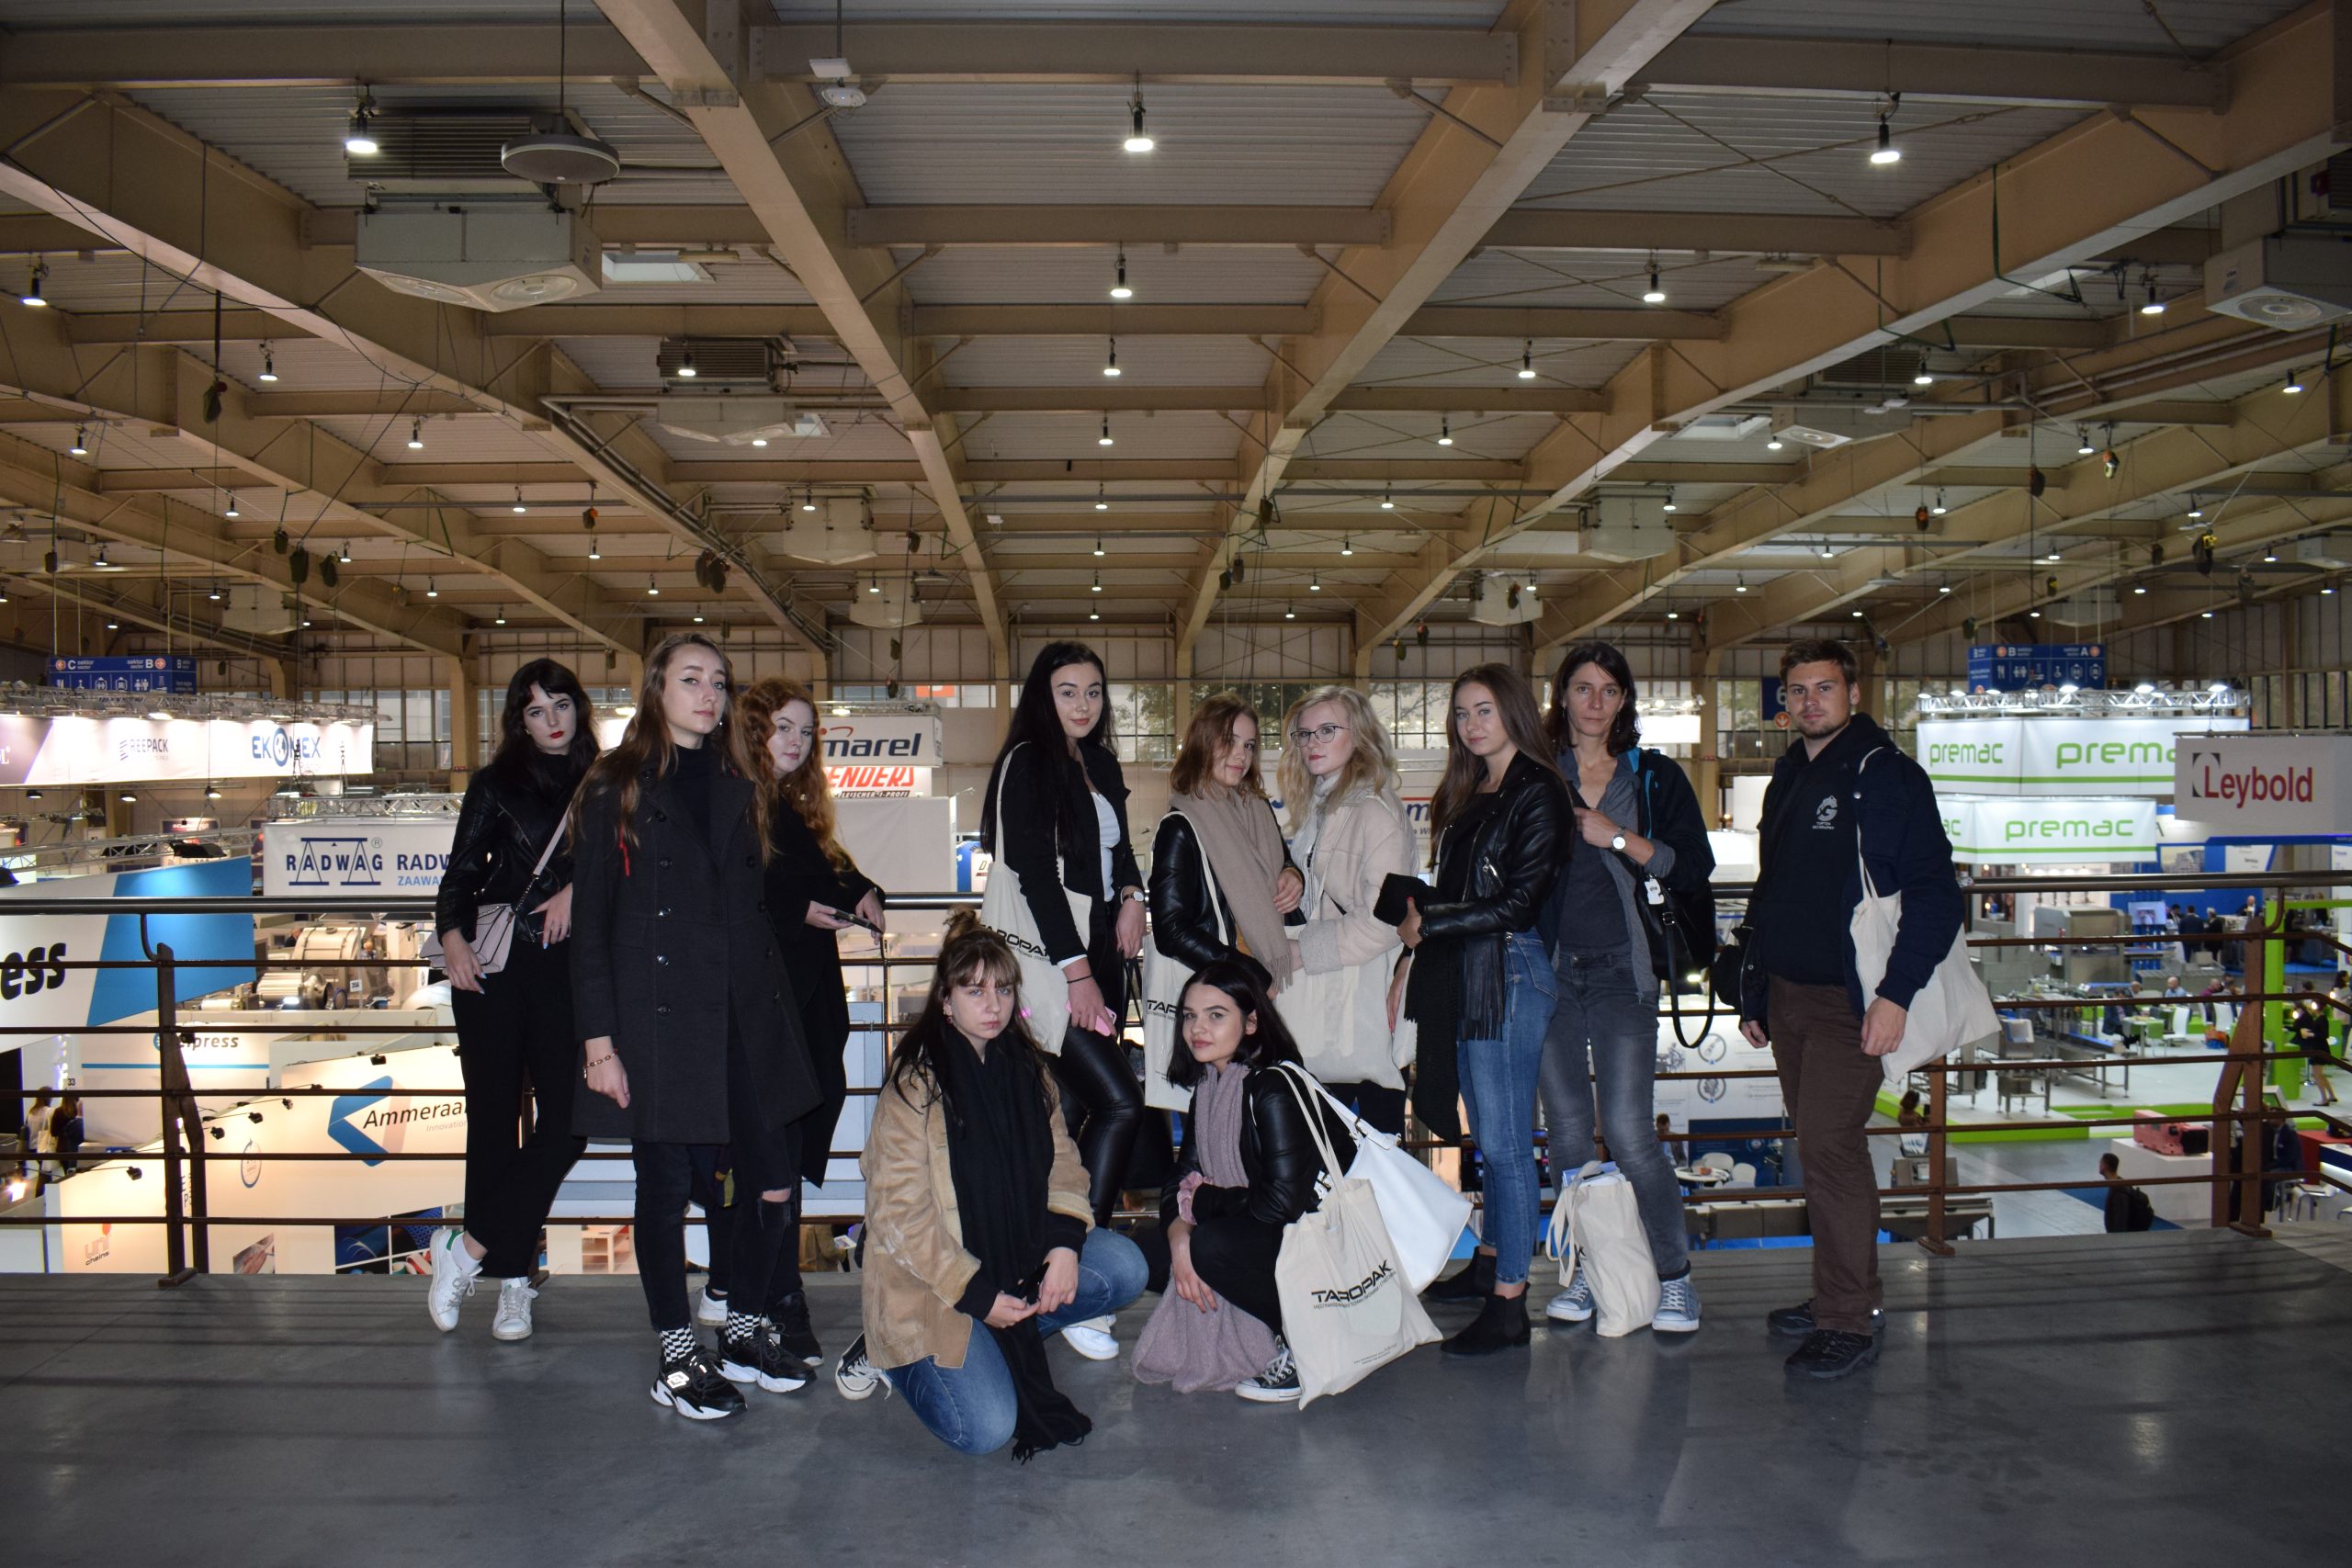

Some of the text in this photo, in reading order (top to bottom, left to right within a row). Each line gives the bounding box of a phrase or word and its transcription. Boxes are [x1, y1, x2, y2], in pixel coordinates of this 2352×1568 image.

[67, 660, 76, 671] C
[145, 659, 153, 669] B
[821, 733, 922, 757] marel
[1929, 743, 2003, 767] premac
[2204, 765, 2312, 808] Leybold
[2006, 820, 2133, 841] premac
[286, 854, 383, 871] RADWAG
[397, 875, 444, 886] ZAAWA
[363, 1101, 467, 1129] Ammeraa
[1311, 1259, 1394, 1303] TAROPAK
